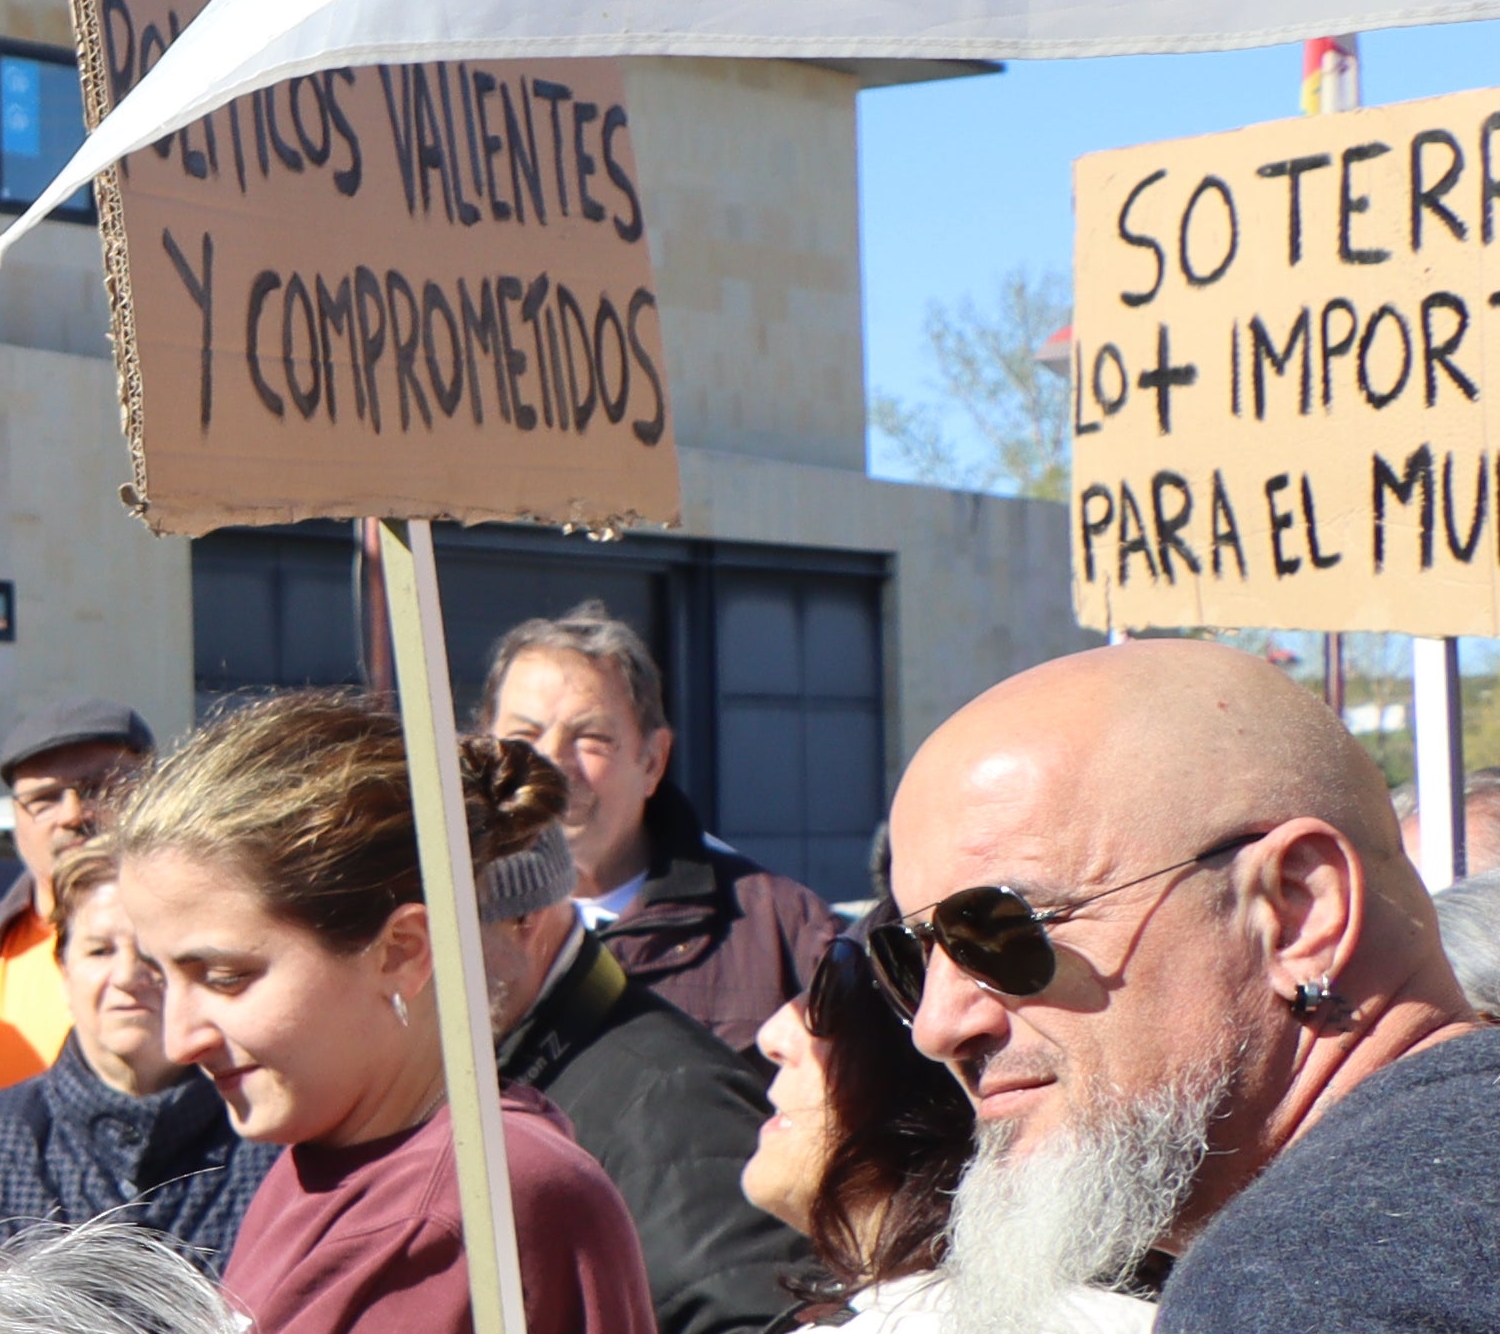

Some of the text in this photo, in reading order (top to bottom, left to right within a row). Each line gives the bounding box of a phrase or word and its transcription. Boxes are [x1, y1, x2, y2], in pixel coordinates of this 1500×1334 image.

[378, 61, 644, 244] VALIENTES
[161, 228, 665, 447] Y COMPROMETIDOS
[1231, 290, 1500, 423] IMPOR
[1081, 442, 1500, 588] PARA EL MU
